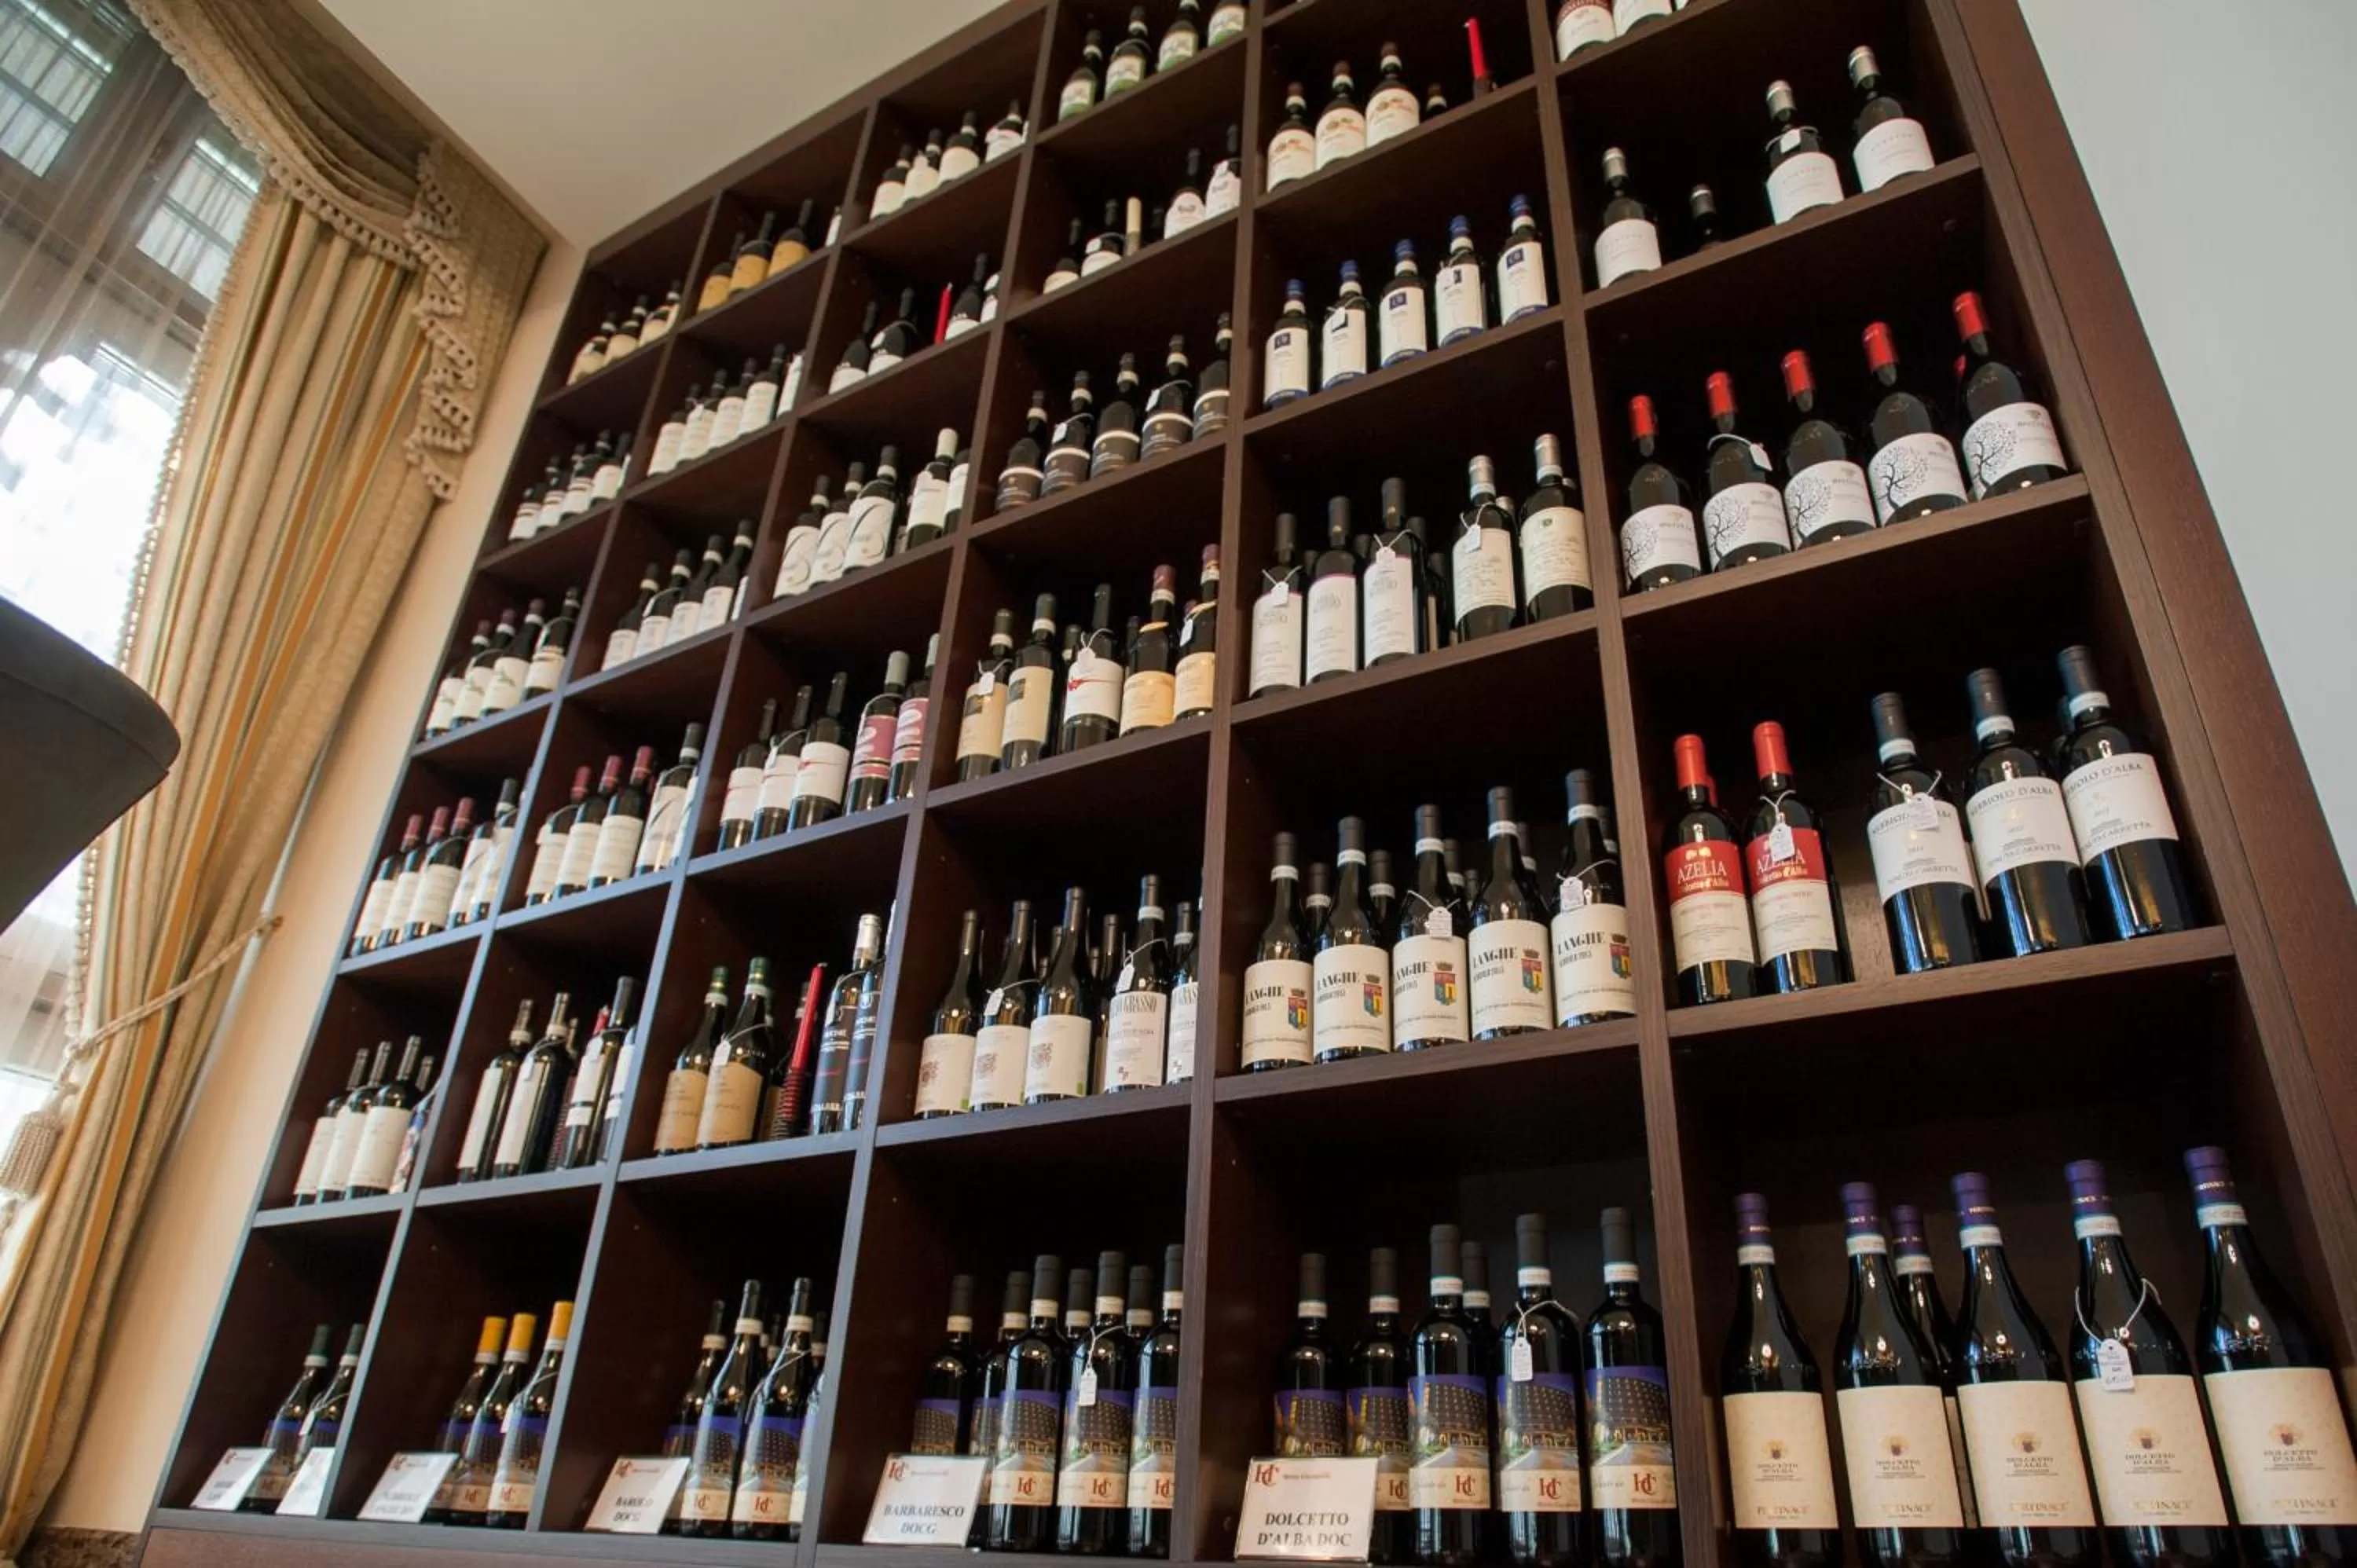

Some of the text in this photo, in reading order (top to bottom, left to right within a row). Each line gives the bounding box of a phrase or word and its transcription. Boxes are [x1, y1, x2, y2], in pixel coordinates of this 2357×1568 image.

[1677, 860, 1727, 885] AZELIA
[1558, 931, 1606, 955] LANGHE
[1472, 947, 1518, 969] LANGHE
[1317, 971, 1360, 991] LANGHE
[1245, 985, 1285, 1006] LANGHE
[884, 1504, 965, 1518] BARBARESCO
[1266, 1512, 1349, 1526] DOLCETTO
[900, 1522, 937, 1534] DOCG
[1257, 1533, 1352, 1546] D'ALBA DOC
